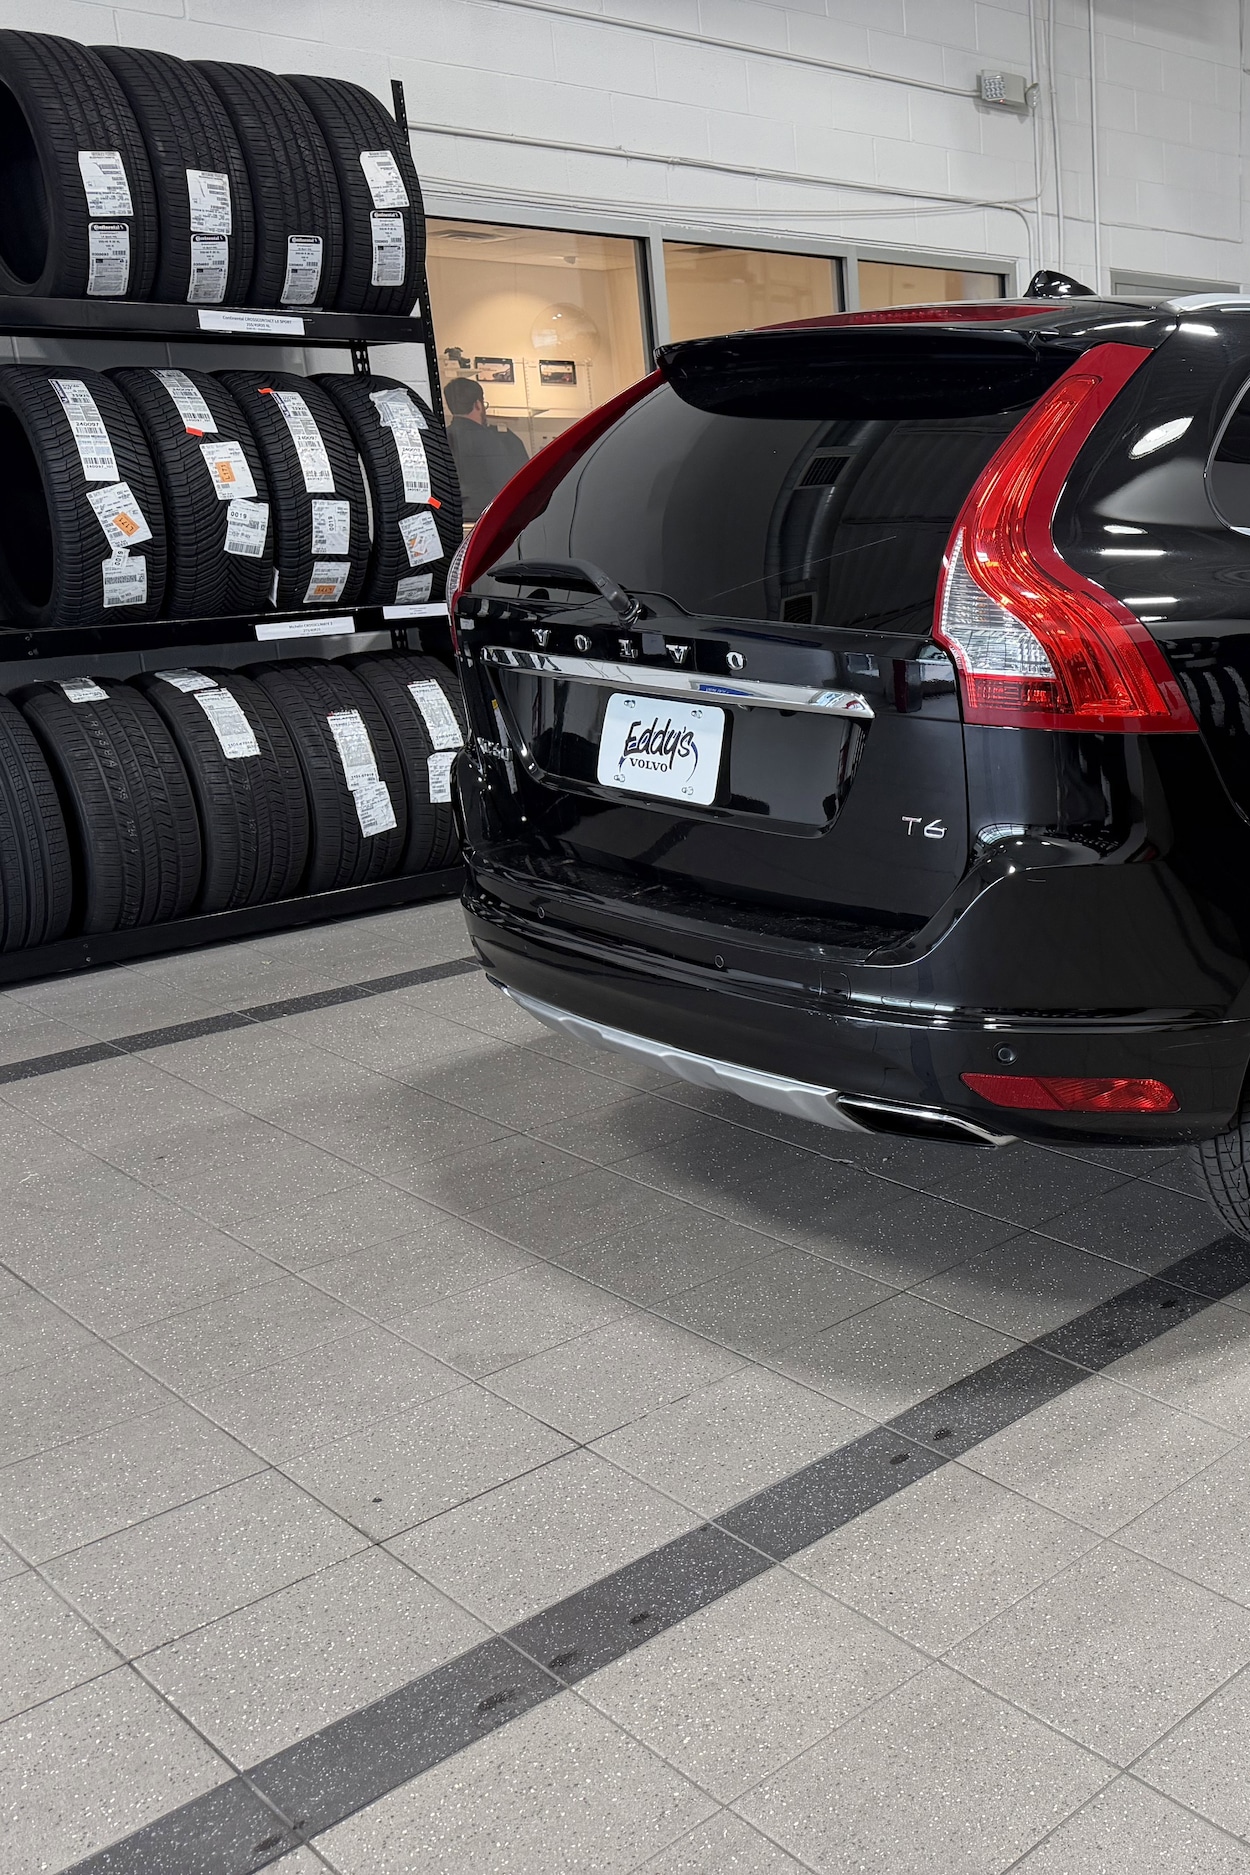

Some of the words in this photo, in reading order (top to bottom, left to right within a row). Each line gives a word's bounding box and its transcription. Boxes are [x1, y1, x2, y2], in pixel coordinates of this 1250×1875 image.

[532, 628, 747, 671] VOLVO
[623, 717, 694, 770] Eddy's
[629, 757, 668, 772] VOLVO
[901, 816, 947, 839] T6
